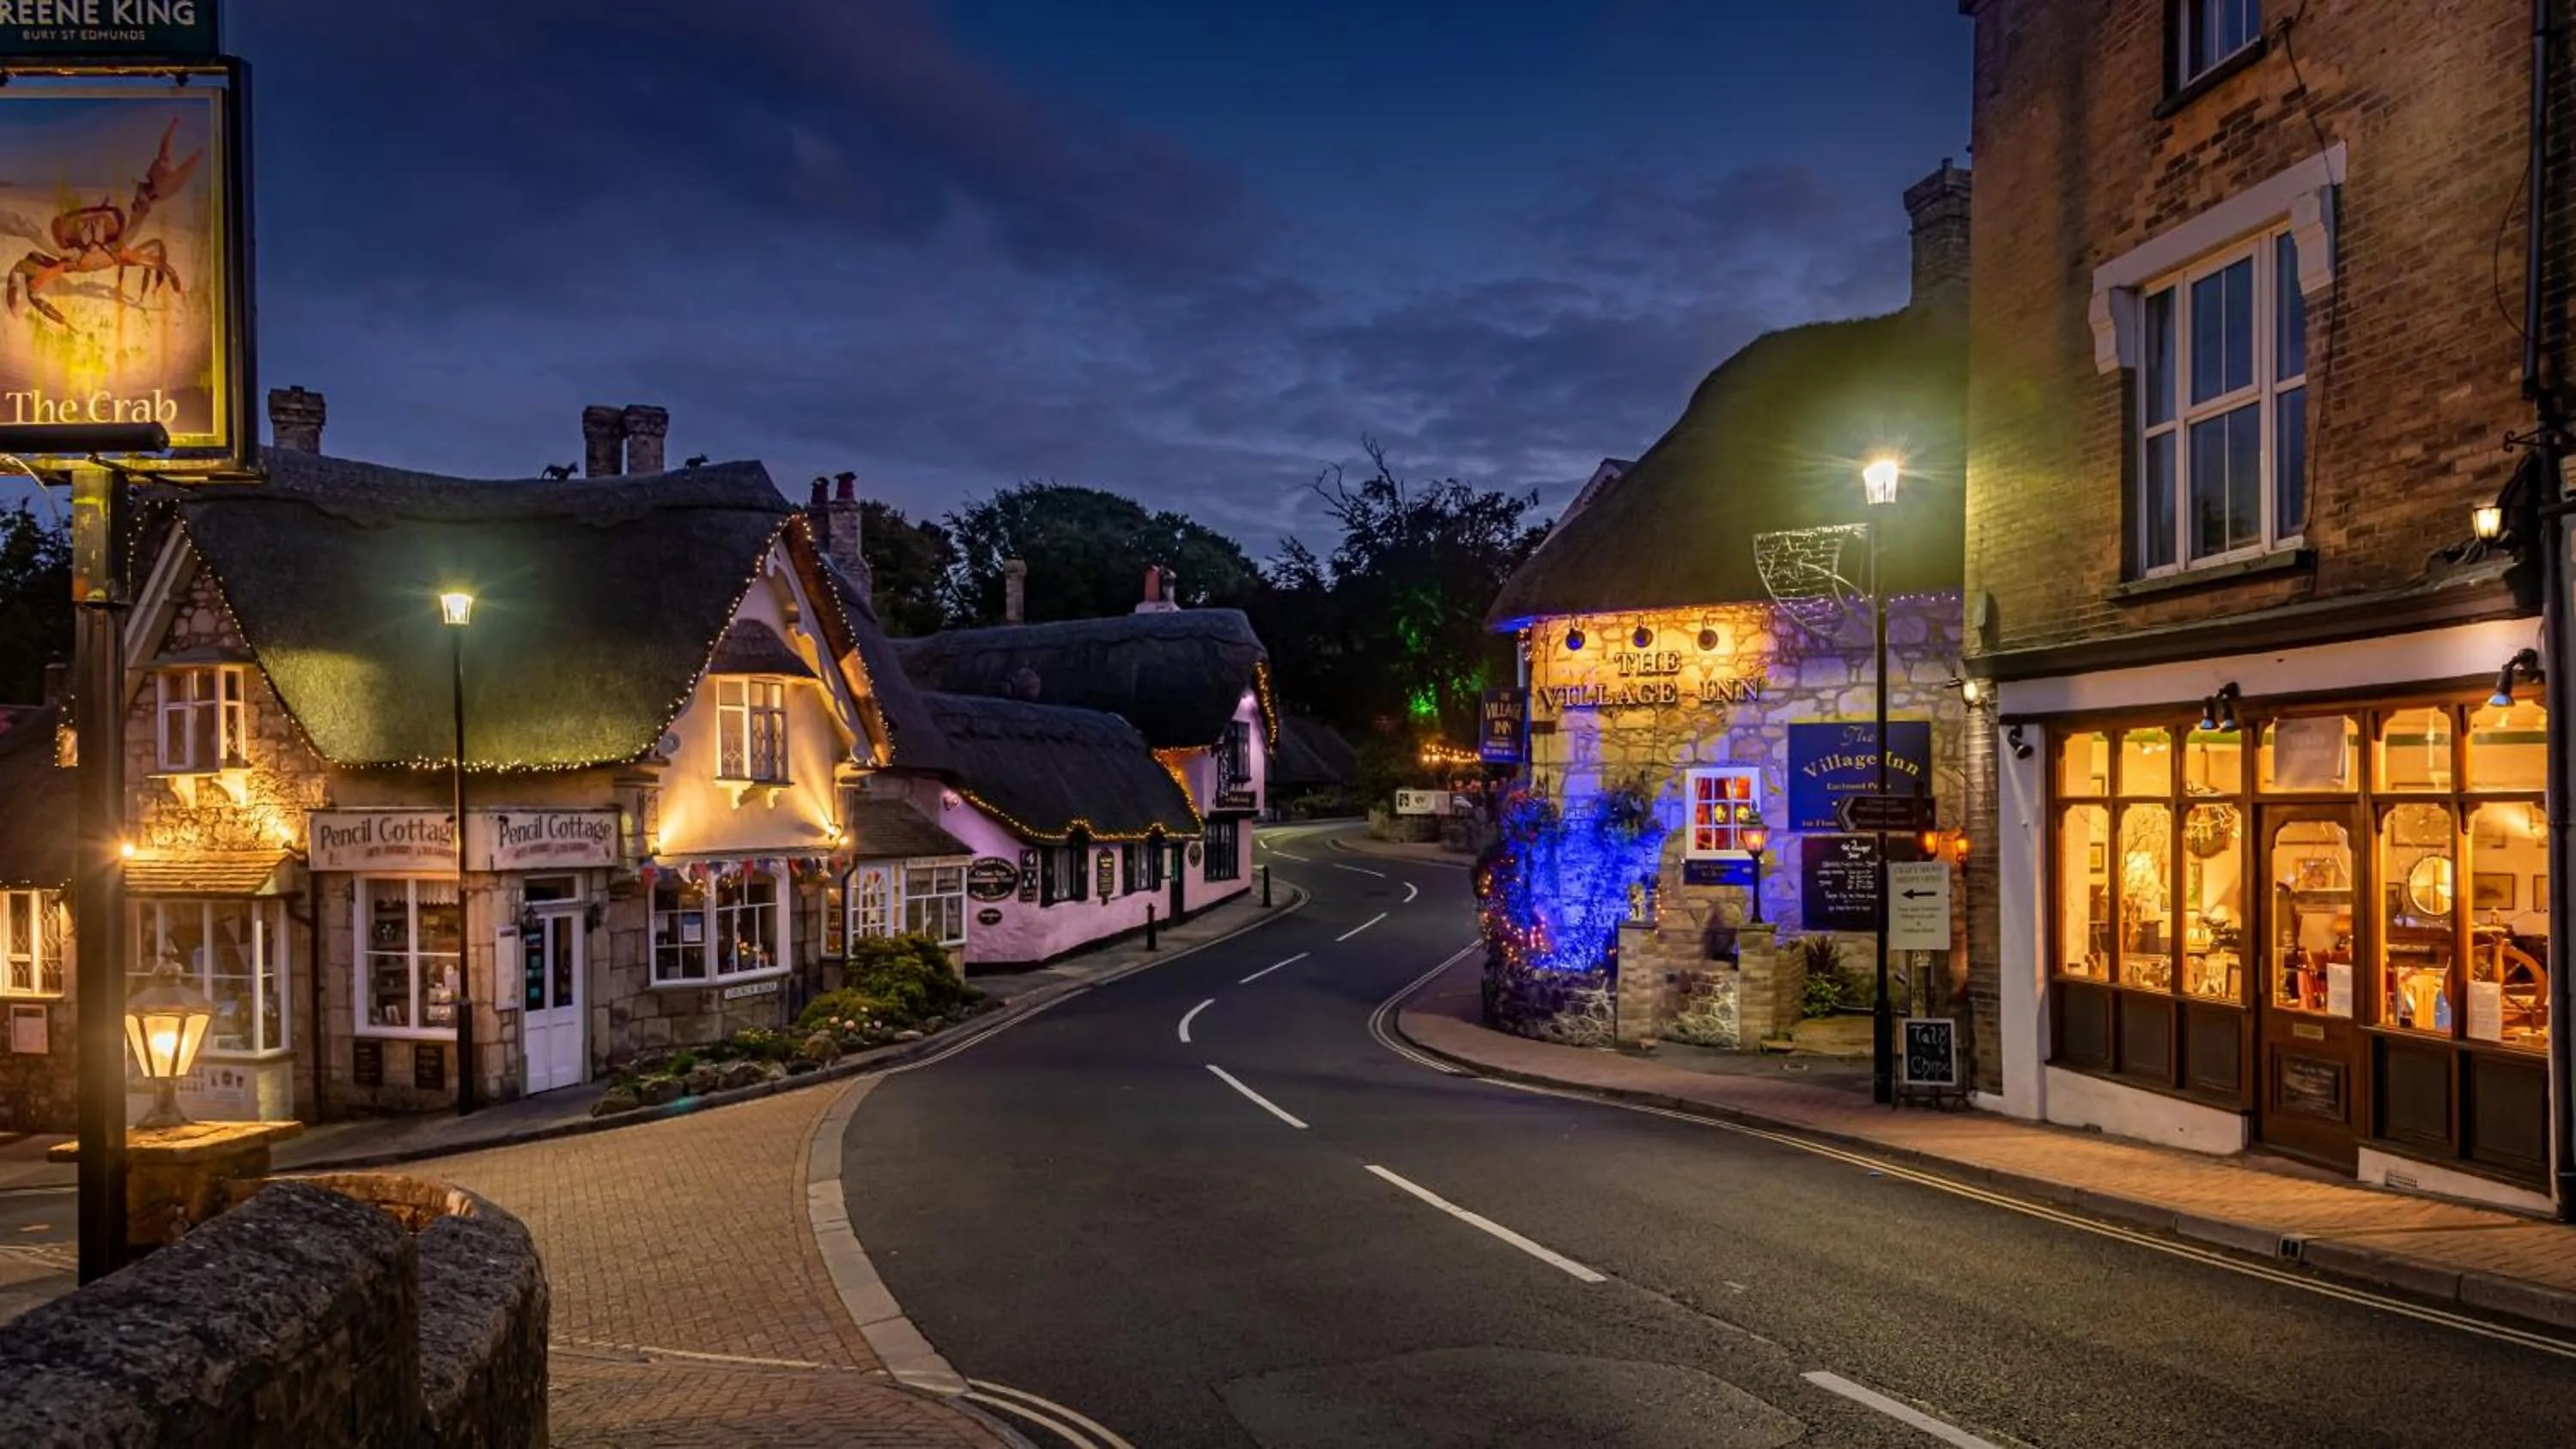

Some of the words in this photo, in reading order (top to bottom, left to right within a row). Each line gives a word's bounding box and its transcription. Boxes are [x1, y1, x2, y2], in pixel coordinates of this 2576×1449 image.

[112, 0, 196, 25] KING
[22, 30, 56, 40] BURY
[62, 30, 75, 40] ST
[82, 30, 145, 40] EDMUNDS
[5, 390, 78, 424] The
[88, 390, 178, 423] Crab
[1615, 652, 1680, 676] THE
[1538, 682, 1677, 708] VILLAGE
[1699, 678, 1761, 704] INN
[1840, 725, 1875, 746] The
[1803, 754, 1878, 778] Village
[1886, 751, 1920, 776] Inn
[320, 818, 372, 851] Pencil
[379, 816, 457, 846] Cottag
[499, 815, 544, 848] Pencil
[549, 815, 612, 846] Cottage
